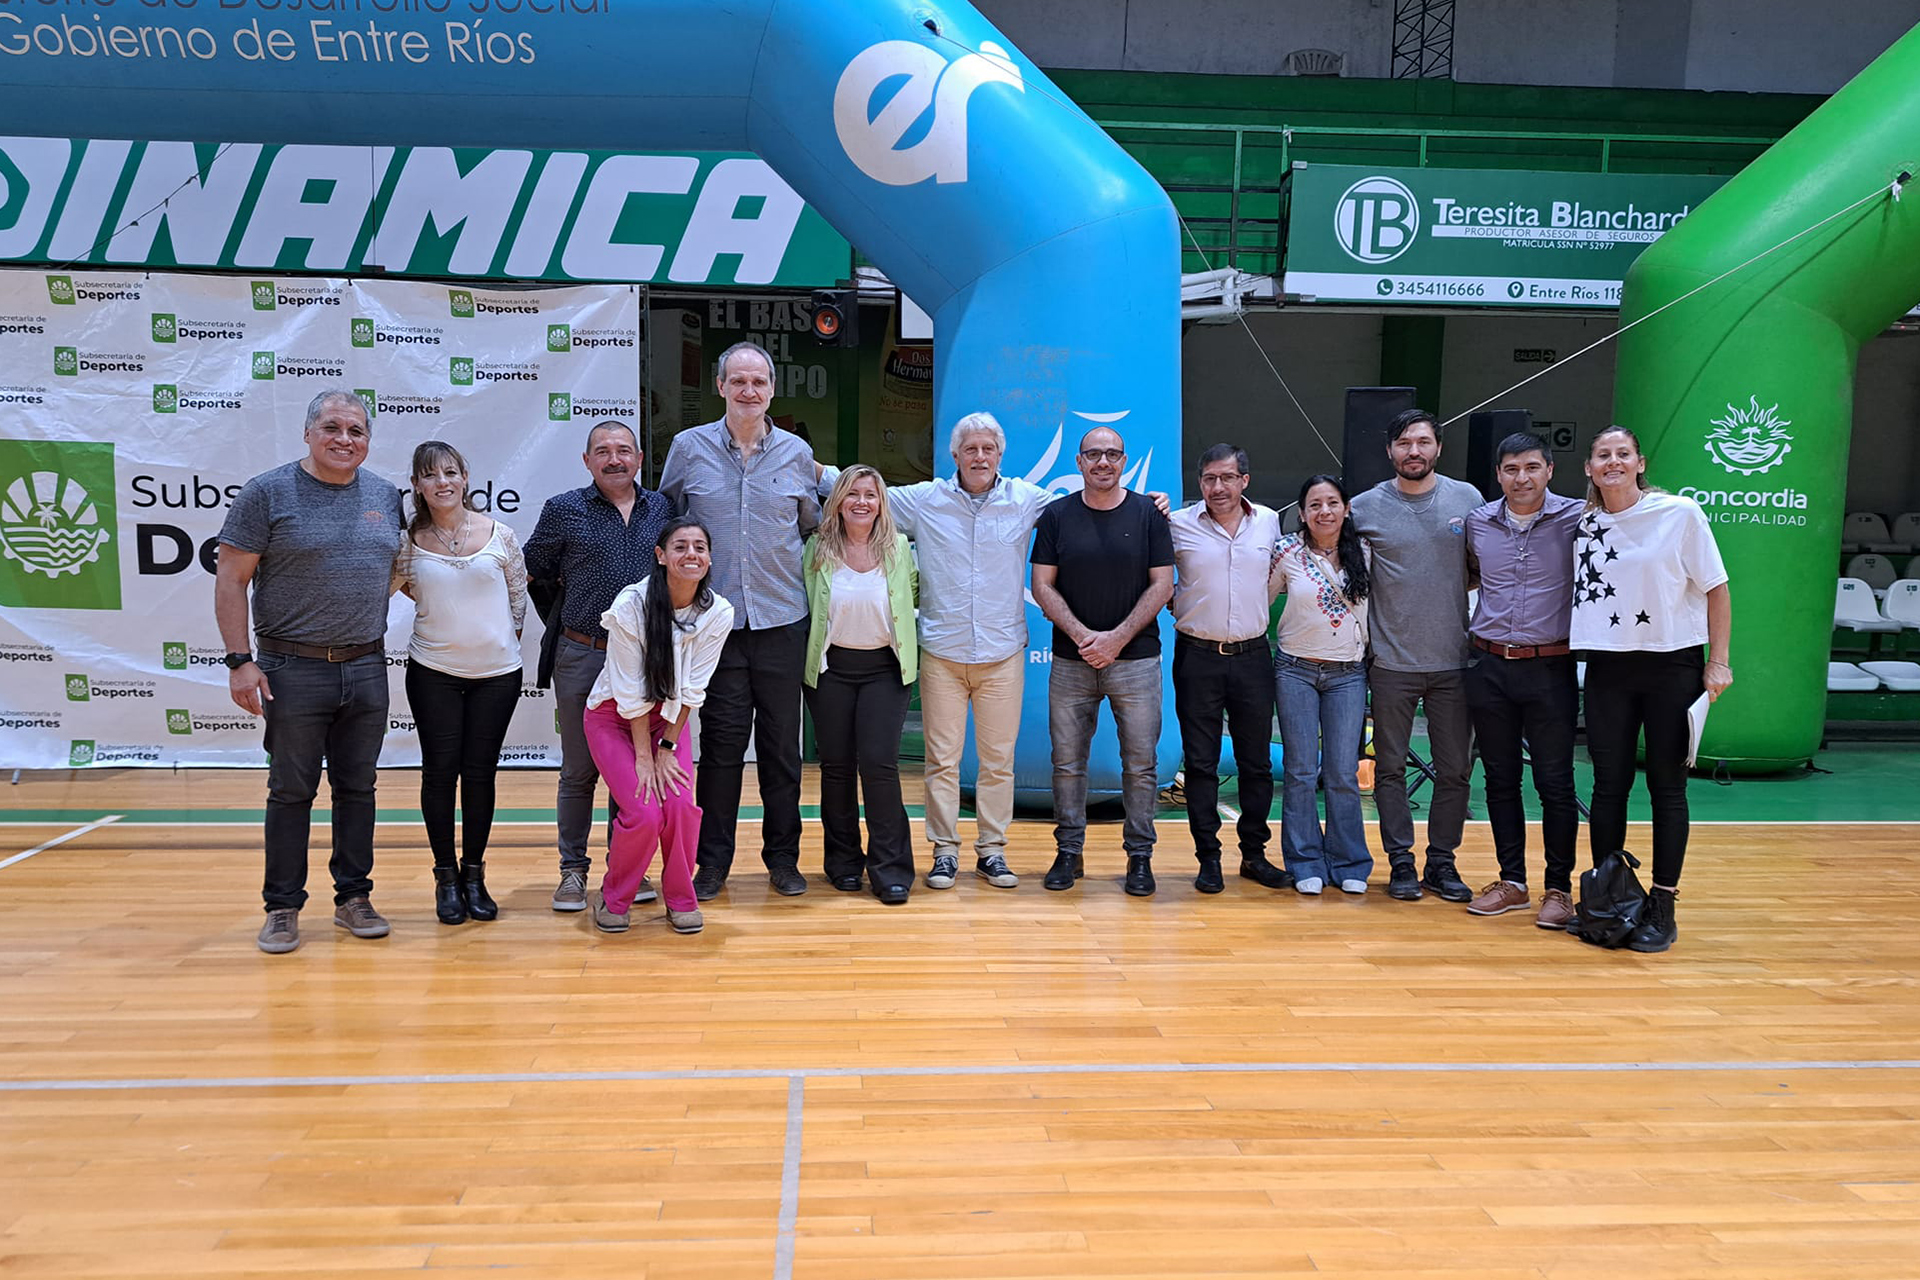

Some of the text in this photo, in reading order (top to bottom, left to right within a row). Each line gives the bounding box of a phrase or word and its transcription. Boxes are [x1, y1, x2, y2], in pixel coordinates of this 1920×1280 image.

[0, 12, 536, 64] Gobierno de Entre Ríos
[1433, 198, 1540, 227] Teresita
[1464, 227, 1655, 241] PRODUCTOR ASESOR DE SEGUROS
[1503, 238, 1554, 249] MATRICULA
[1557, 240, 1574, 249] SSN
[1590, 242, 1615, 251] 52977
[1397, 281, 1485, 297] 3454116666
[1530, 284, 1566, 299] Entre
[1571, 286, 1600, 300] Ríos
[77, 290, 141, 301] Deportes
[278, 296, 340, 306] Deportes
[477, 303, 539, 314] Deportes
[36, 315, 47, 323] de
[709, 299, 740, 329] EL
[750, 299, 811, 331] BAS
[0, 324, 44, 334] portes
[179, 328, 243, 339] Deportes
[433, 325, 444, 333] de
[376, 332, 441, 344] Deportes
[573, 337, 634, 348] Deportes
[80, 361, 144, 372] Deportes
[277, 365, 343, 376] Deportes
[476, 371, 538, 381] Deportes
[0, 394, 43, 404] ortes
[179, 399, 241, 409] Deportes
[378, 403, 441, 414] Deportes
[573, 406, 635, 416] Deportes
[1553, 427, 1573, 447] G
[474, 481, 520, 513] de
[1677, 486, 1808, 509] Concordia
[1707, 512, 1807, 527] NICIPALIDAD
[0, 652, 53, 662] eportes
[190, 655, 226, 666] Depo
[92, 688, 154, 698] Deportes
[518, 688, 545, 698] rtes
[193, 721, 256, 731] Deportes
[96, 752, 159, 761] Deportes
